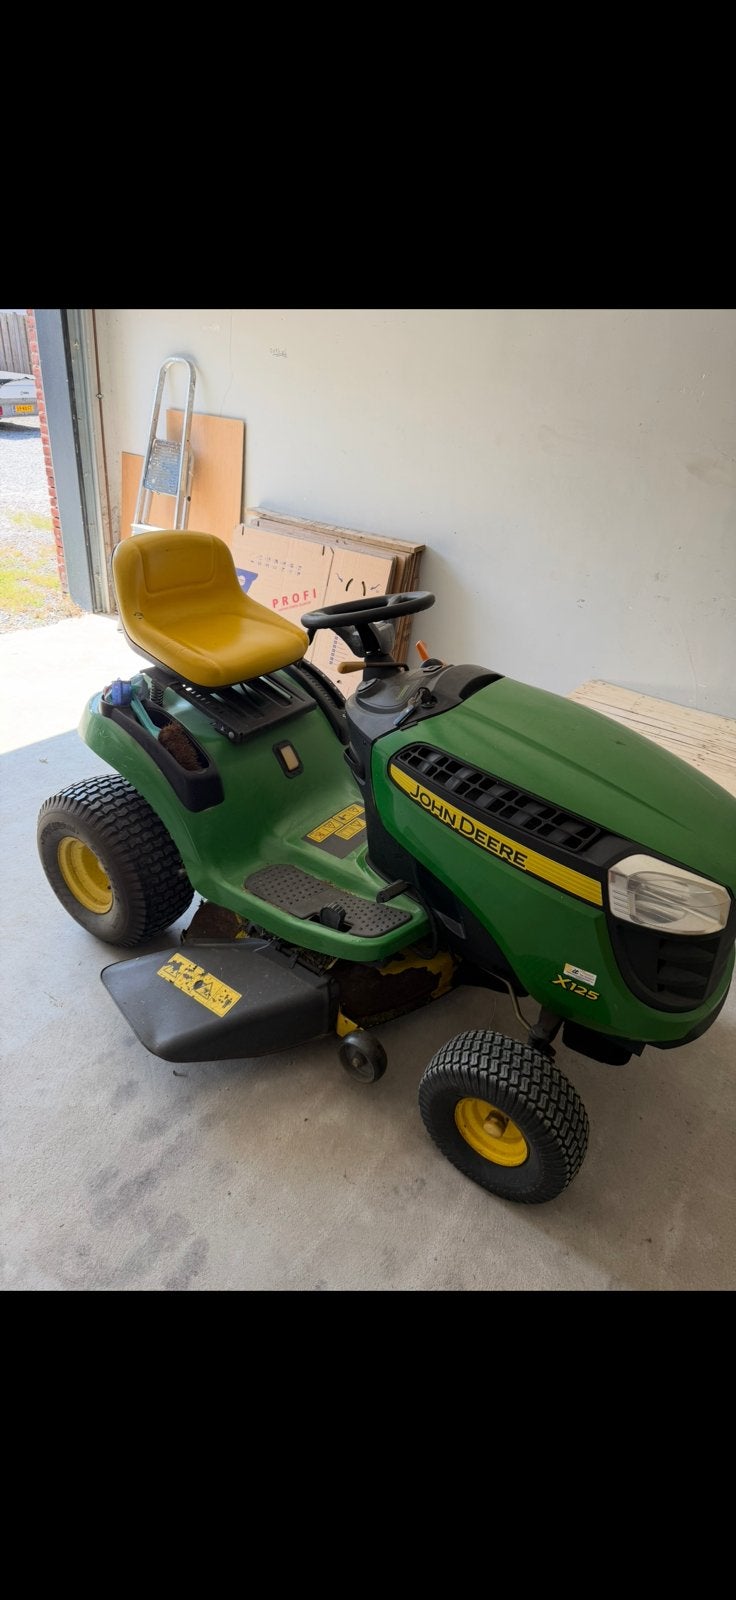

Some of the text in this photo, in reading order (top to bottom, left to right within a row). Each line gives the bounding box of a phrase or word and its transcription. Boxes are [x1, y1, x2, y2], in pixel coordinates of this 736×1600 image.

[272, 587, 317, 609] PROFI
[409, 785, 529, 868] JOHN DEERE
[551, 974, 600, 1000] X125
